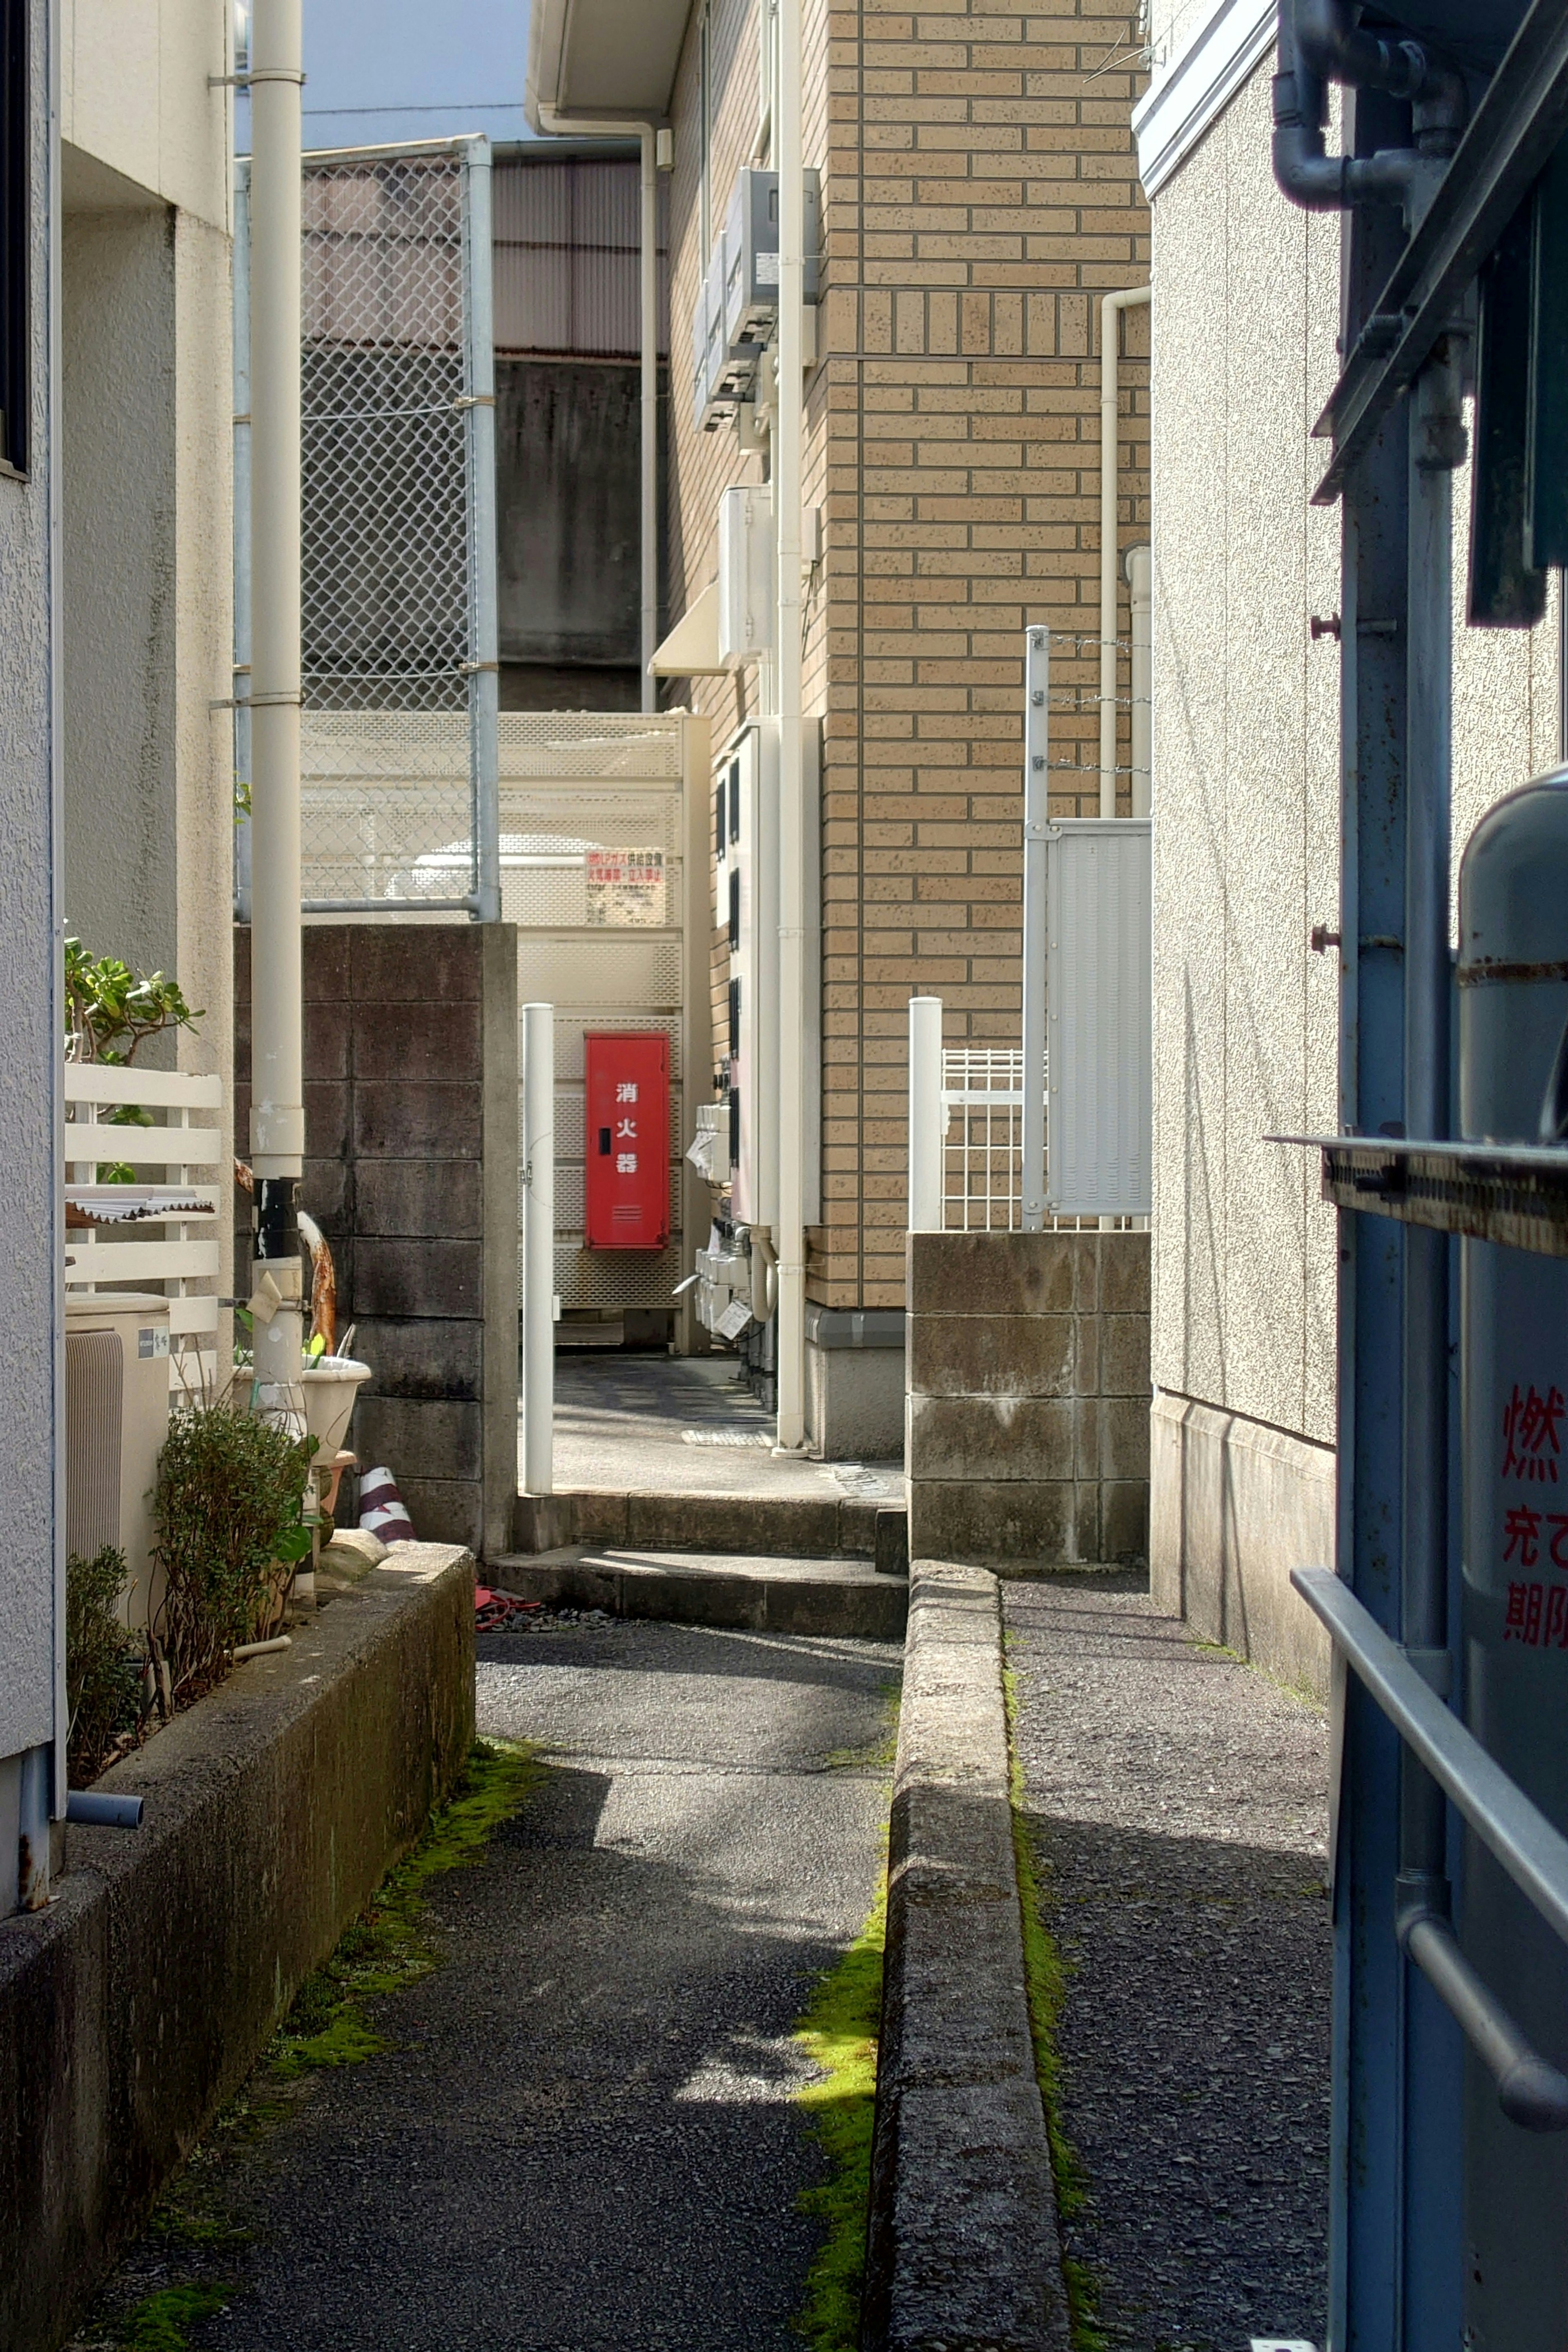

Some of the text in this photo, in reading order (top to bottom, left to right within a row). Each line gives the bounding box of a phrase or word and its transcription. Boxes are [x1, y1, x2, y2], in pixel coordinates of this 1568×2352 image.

[616, 1082, 638, 1174] 消火器
[1502, 1384, 1566, 1483] 燃
